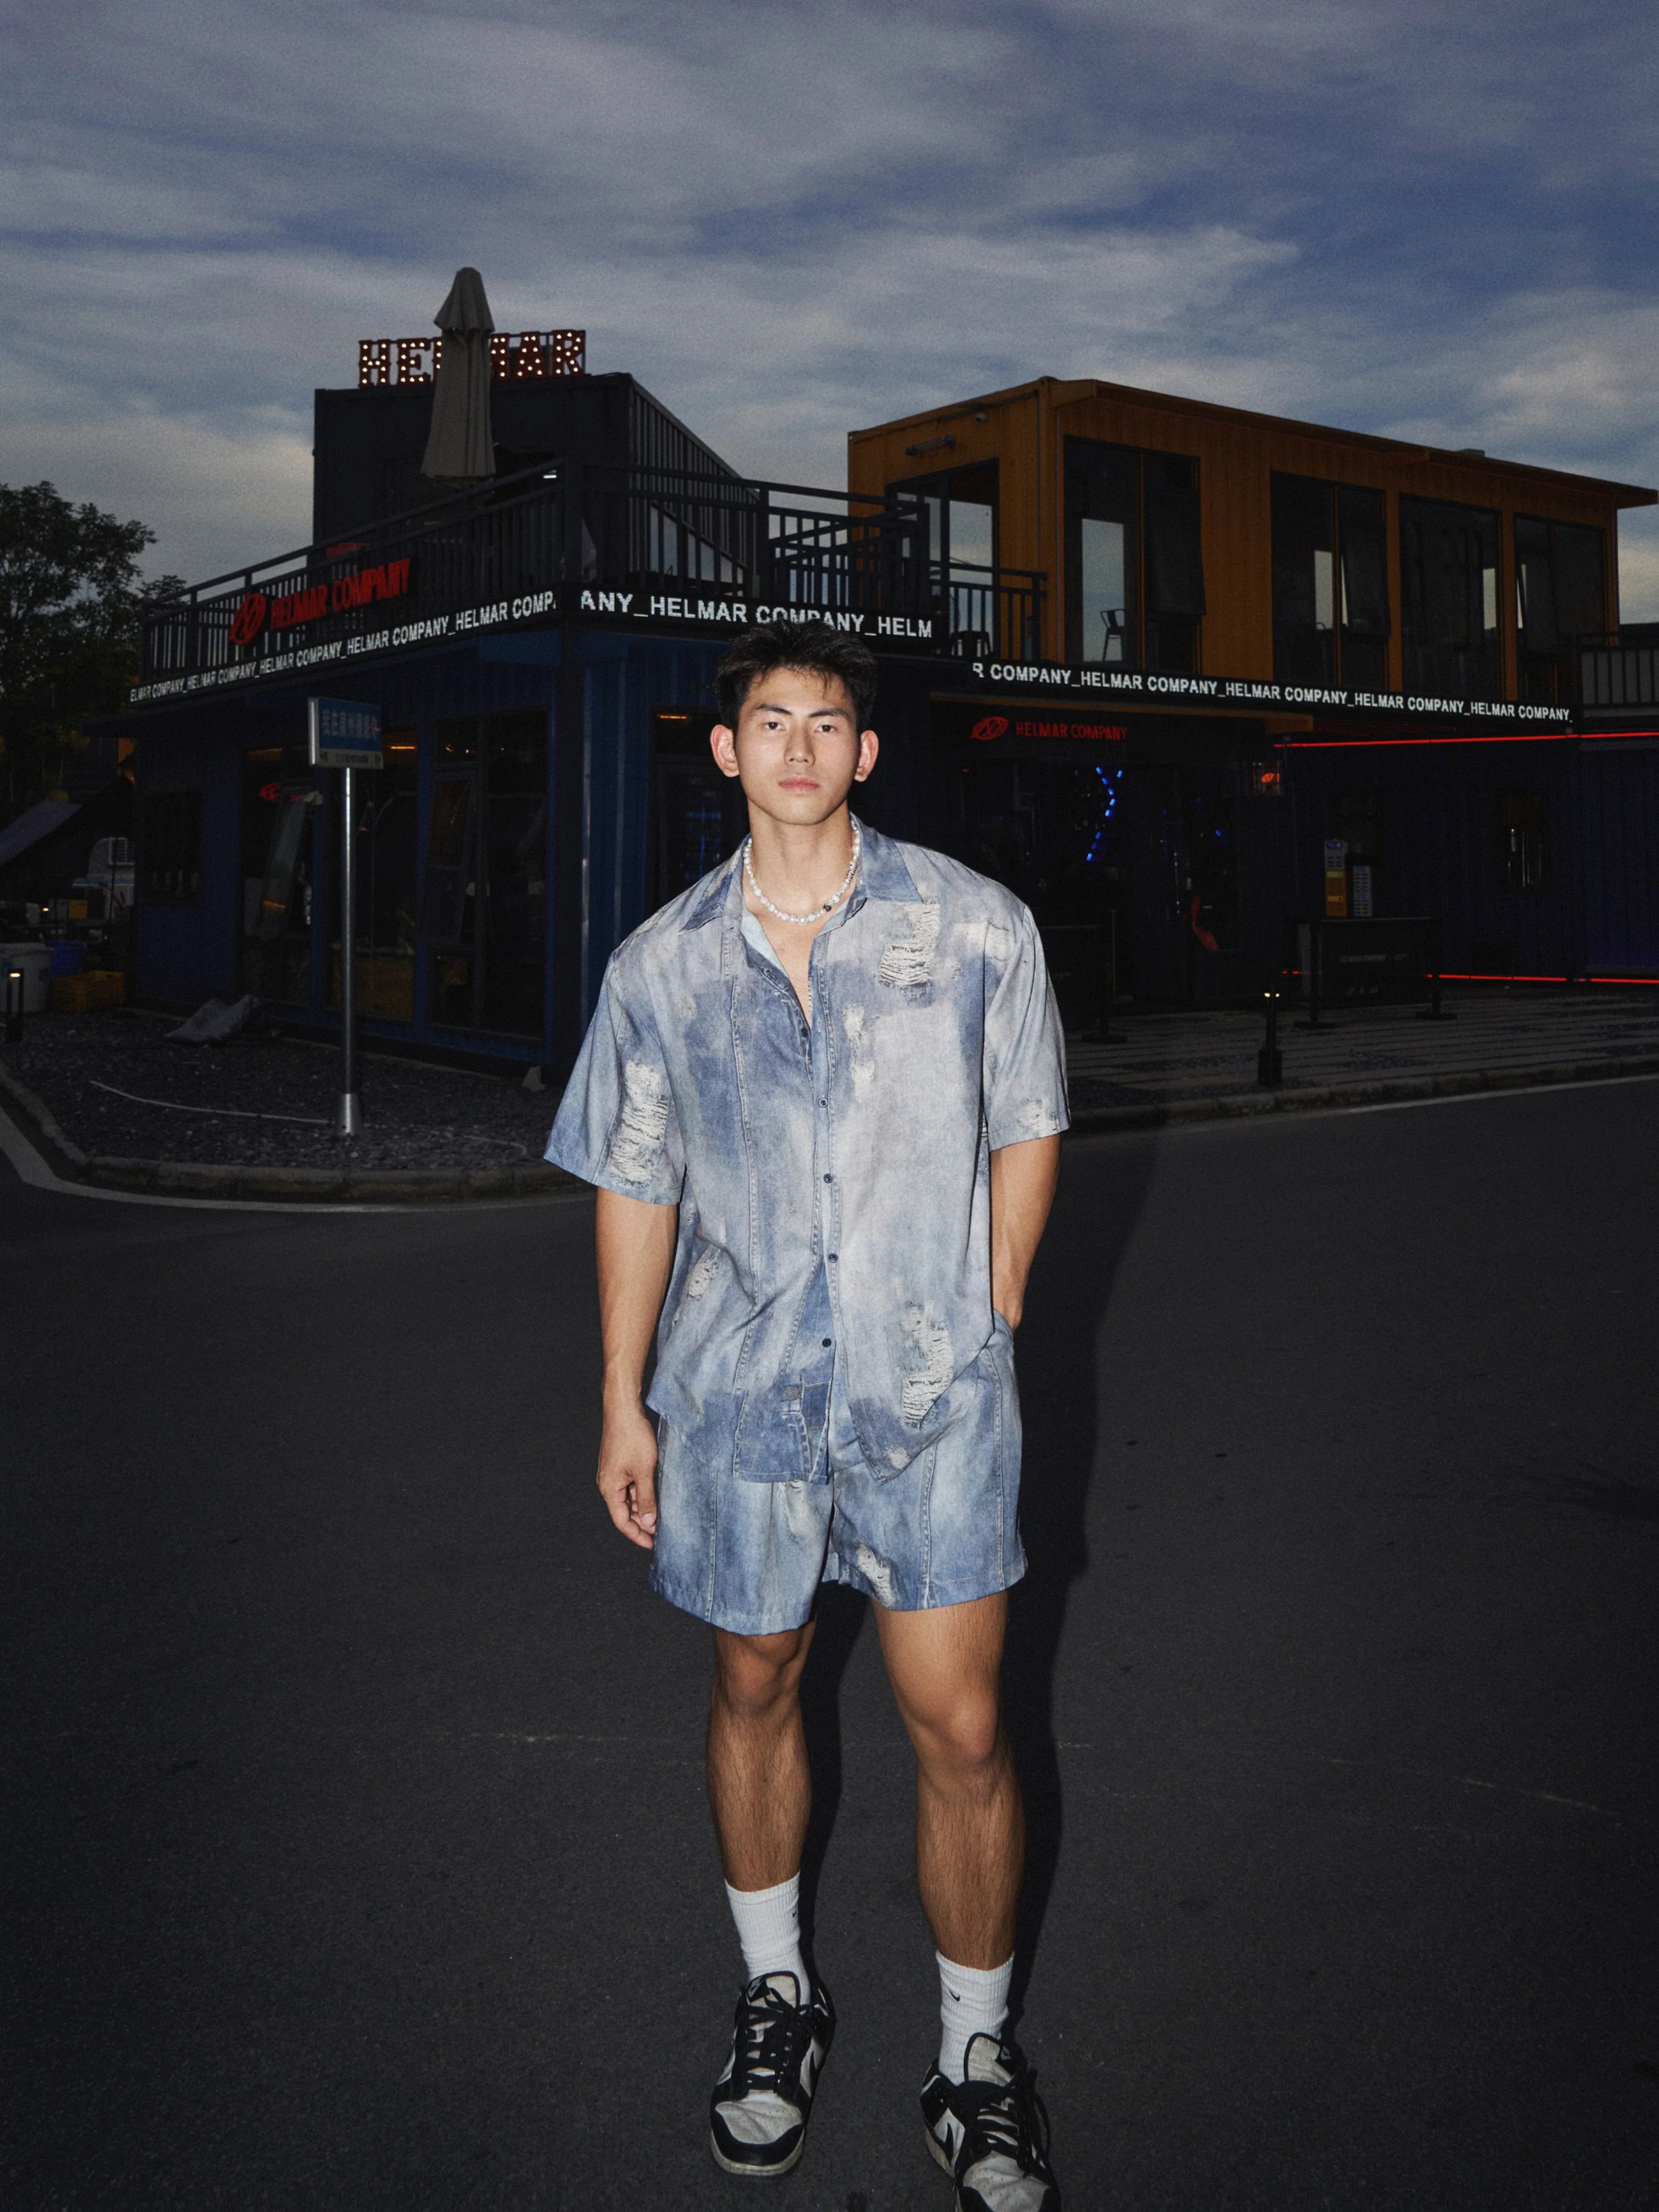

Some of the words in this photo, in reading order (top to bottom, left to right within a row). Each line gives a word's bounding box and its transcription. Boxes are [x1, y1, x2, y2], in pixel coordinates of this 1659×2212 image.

[270, 584, 328, 630] HELMAR
[332, 558, 411, 612] COMPANY
[512, 591, 556, 619] COMP
[1016, 721, 1068, 738] HELMAR
[1070, 724, 1127, 740] COMPANY
